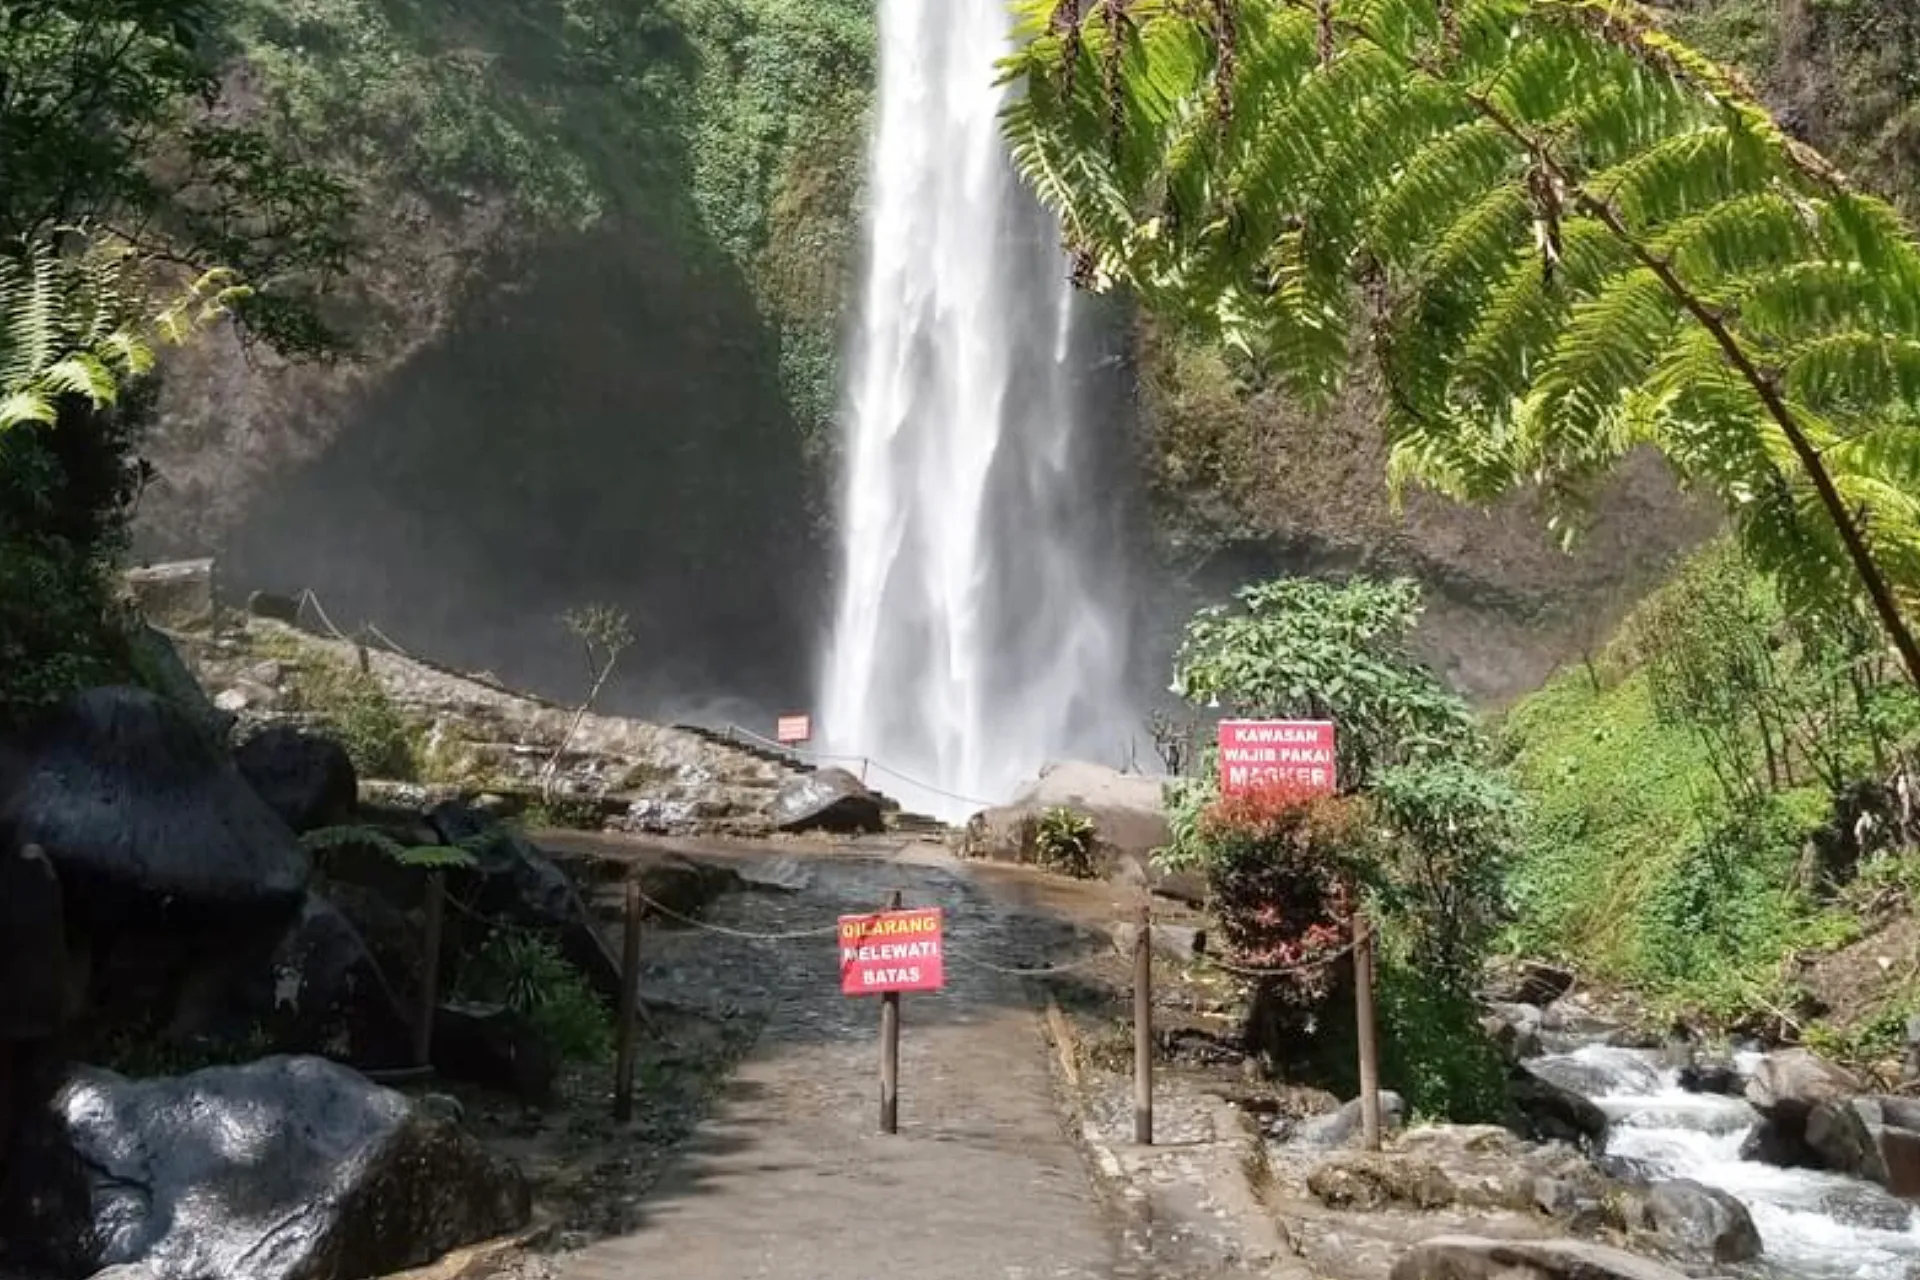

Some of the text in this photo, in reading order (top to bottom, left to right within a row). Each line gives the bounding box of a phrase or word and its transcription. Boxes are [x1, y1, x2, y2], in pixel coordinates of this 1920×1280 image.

[1235, 728, 1318, 743] KAWASAN
[1225, 748, 1330, 762] WAJIB PAKAI
[842, 917, 937, 938] DILARANG
[843, 942, 937, 961] MELEWATI
[863, 967, 920, 985] BATAS
